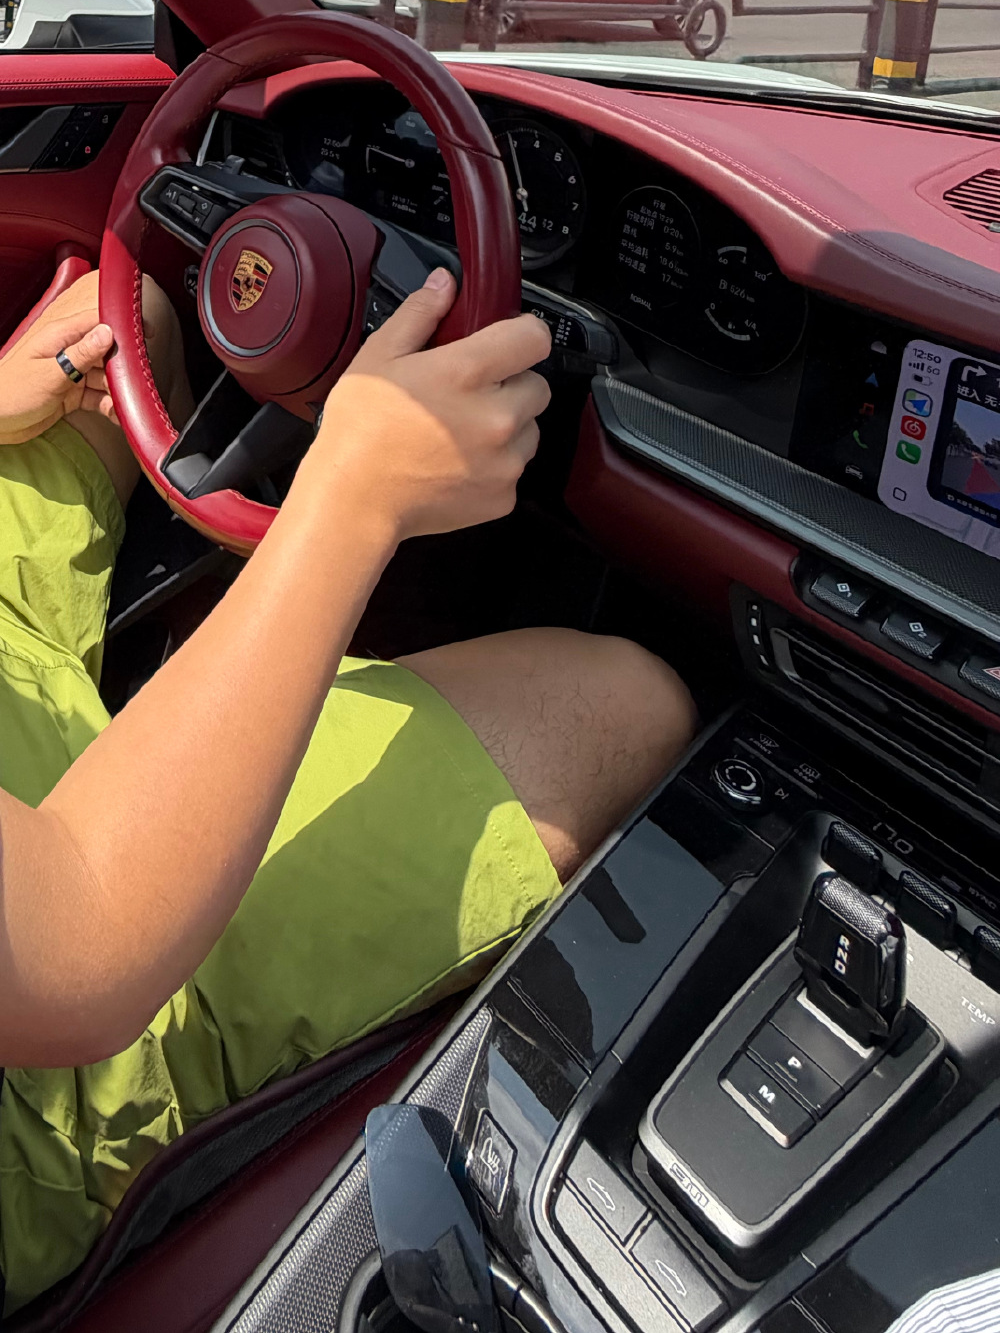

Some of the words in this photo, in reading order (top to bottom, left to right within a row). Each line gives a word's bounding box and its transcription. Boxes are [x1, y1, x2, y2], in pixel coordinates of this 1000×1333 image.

[533, 140, 541, 149] 4
[553, 152, 563, 162] 5
[567, 175, 577, 185] 6
[571, 201, 580, 212] 7
[517, 212, 537, 229] 44
[561, 225, 570, 235] 8
[913, 348, 942, 364] 12:50
[956, 384, 981, 402] 进入
[838, 934, 850, 949] R
[836, 947, 848, 961] N
[834, 960, 846, 975] D
[961, 996, 996, 1025] TEMP
[787, 1055, 801, 1068] P
[758, 1084, 775, 1104] M
